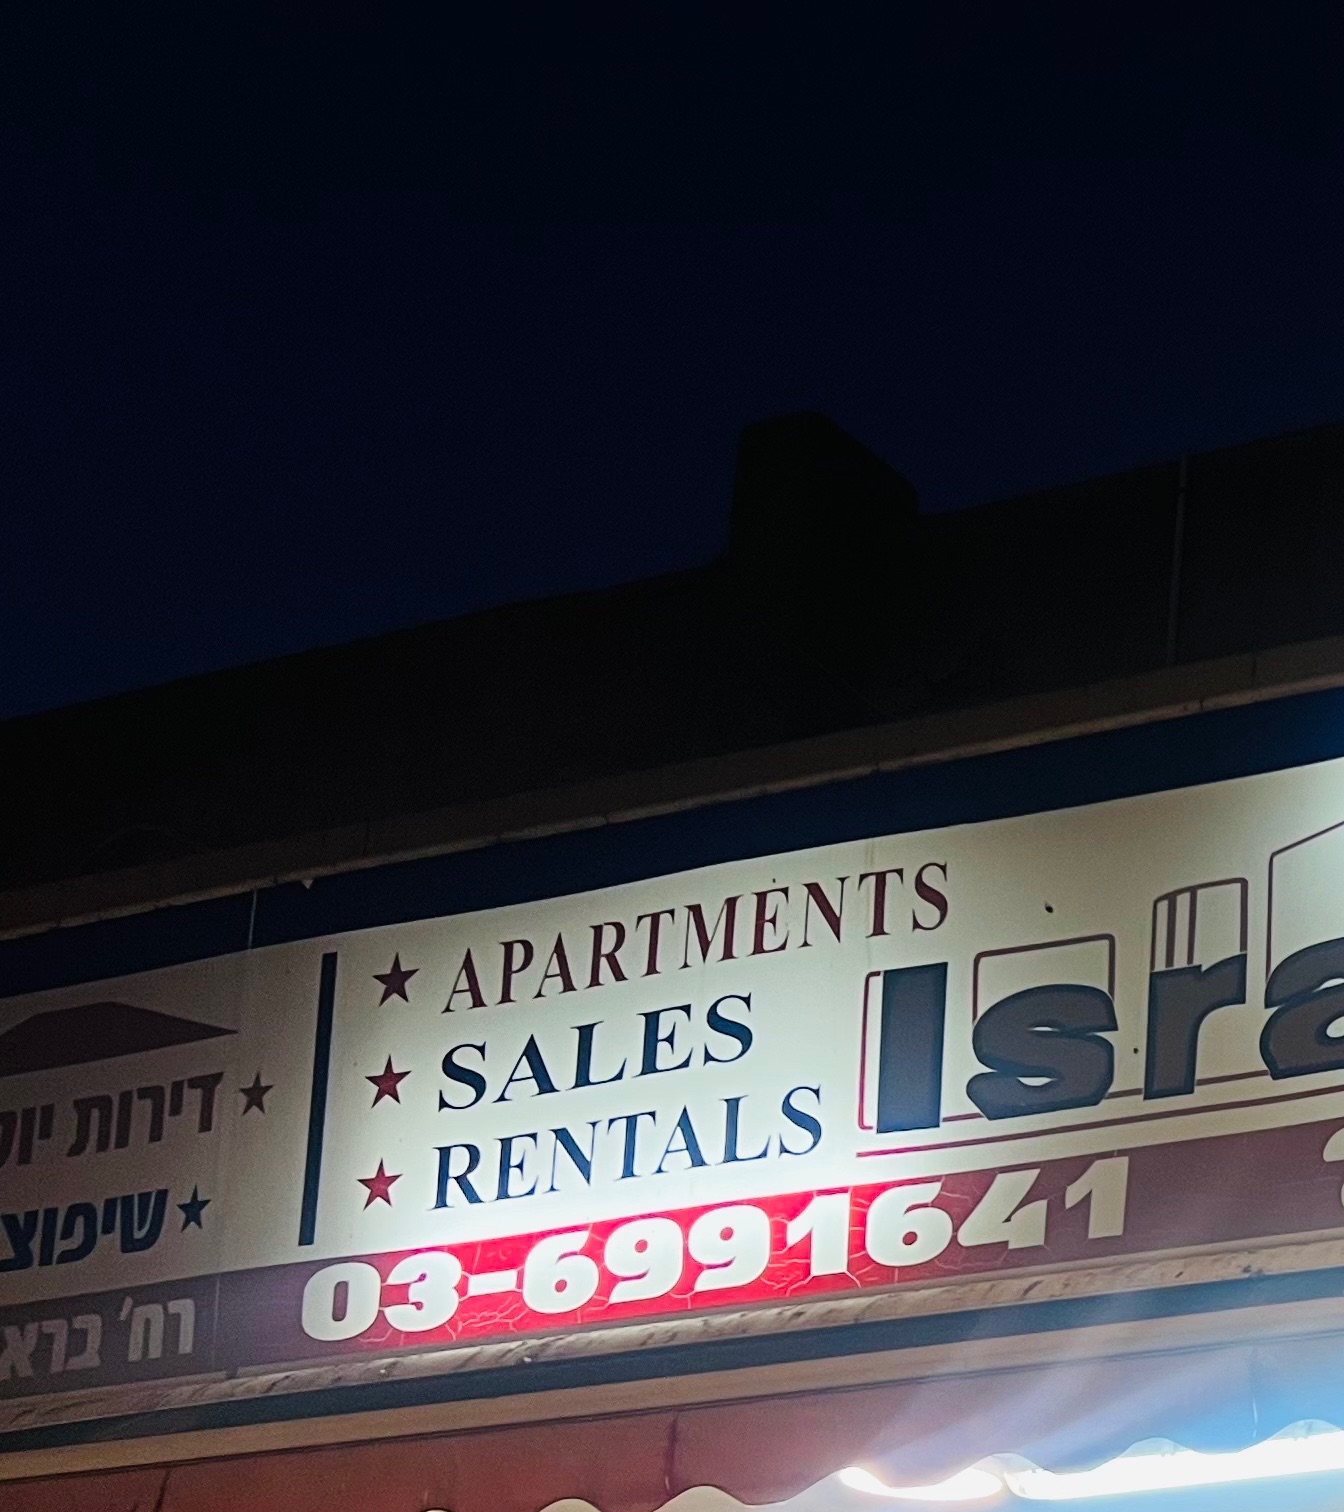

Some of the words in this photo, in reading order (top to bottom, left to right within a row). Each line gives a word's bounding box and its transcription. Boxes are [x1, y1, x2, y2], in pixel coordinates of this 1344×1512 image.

[441, 861, 950, 1015] APARTMENTS
[66, 1070, 225, 1158] דירות
[437, 991, 755, 1112] SALES
[430, 1084, 824, 1211] RENTALS
[300, 1154, 1130, 1343] 03-6991641
